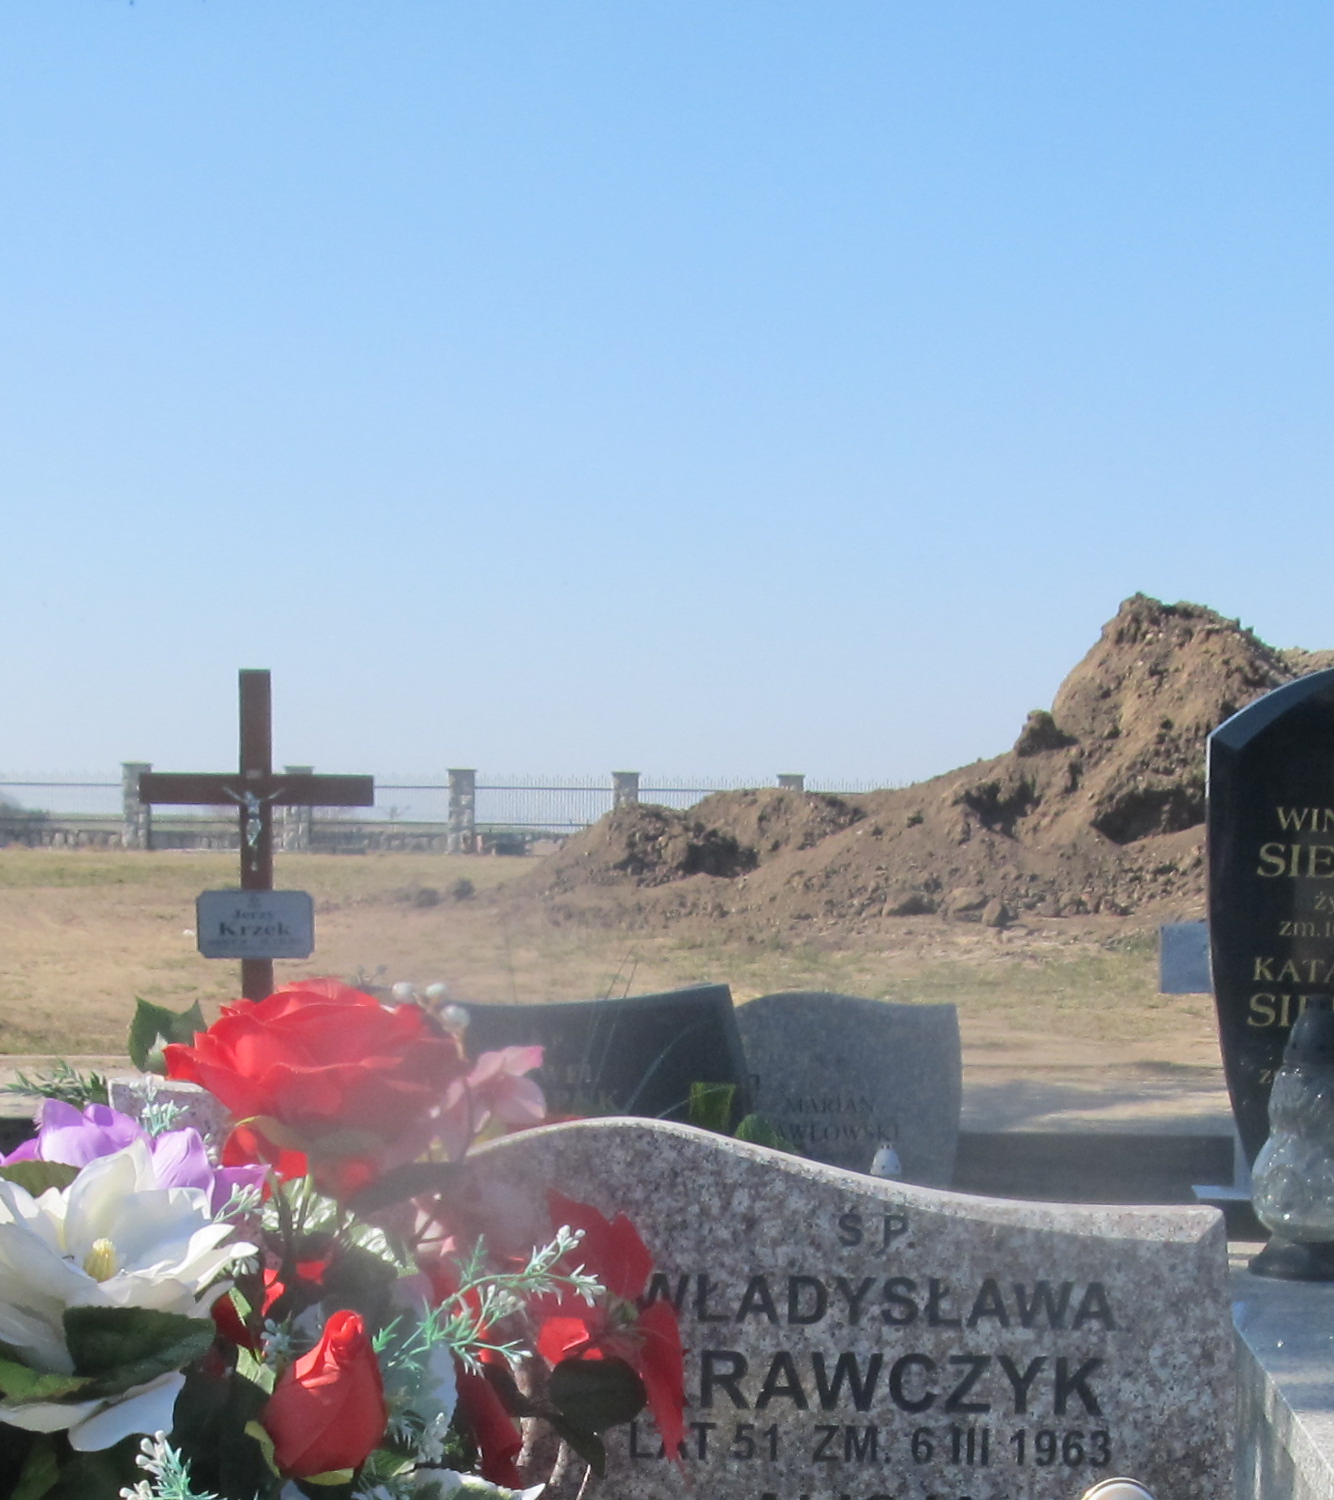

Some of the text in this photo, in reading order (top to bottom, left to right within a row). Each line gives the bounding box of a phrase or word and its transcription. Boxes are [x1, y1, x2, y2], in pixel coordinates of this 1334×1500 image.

[218, 922, 292, 936] Krzek
[777, 1122, 900, 1143] AWŁOWSKI
[681, 1349, 1105, 1417] RAWCZYK
[732, 1422, 780, 1463] 51
[811, 1423, 893, 1466] ZM.
[911, 1425, 936, 1466] 6
[950, 1427, 991, 1467] III
[1010, 1429, 1113, 1469] 1963
